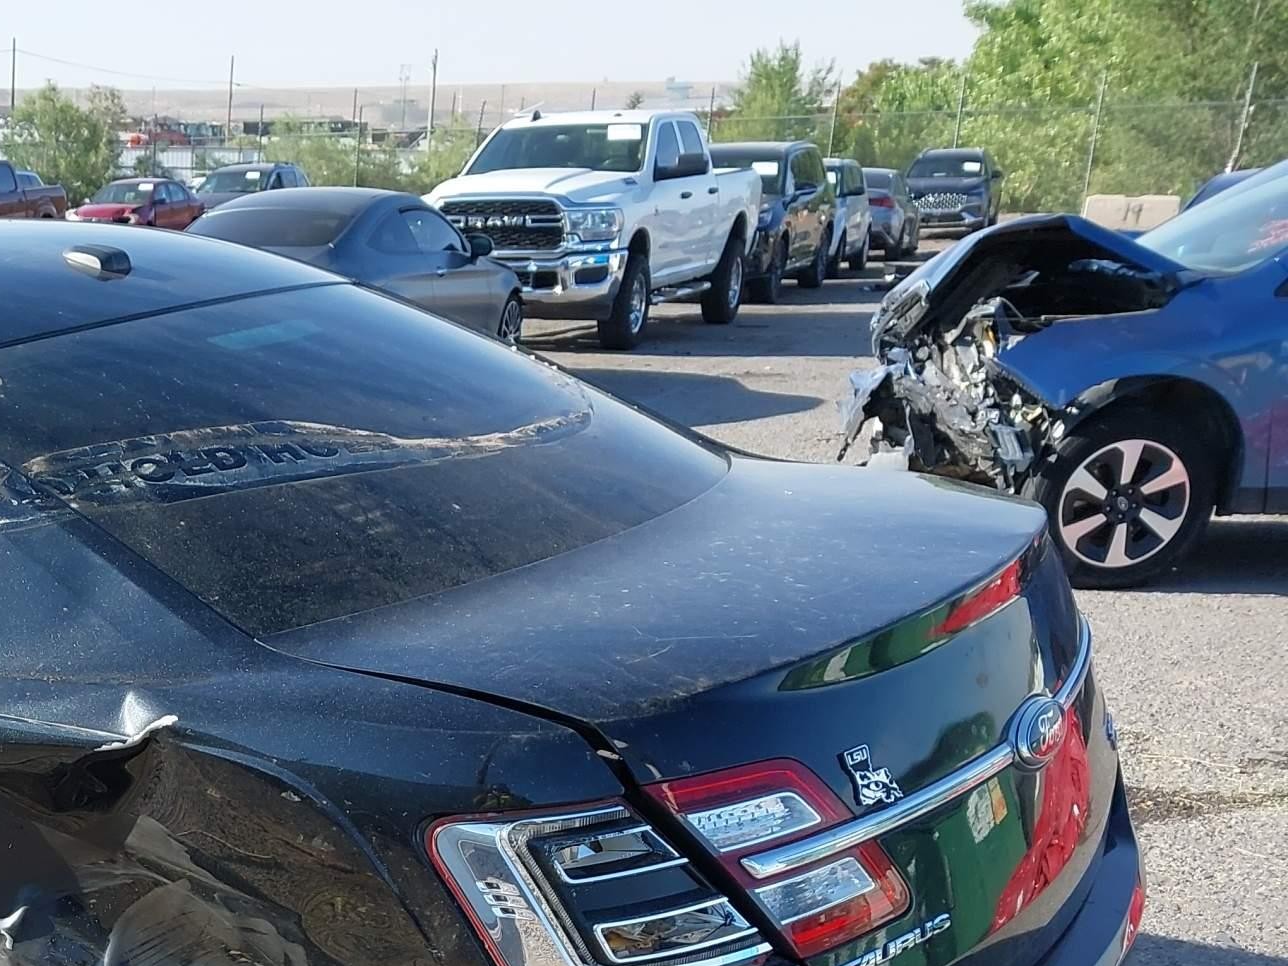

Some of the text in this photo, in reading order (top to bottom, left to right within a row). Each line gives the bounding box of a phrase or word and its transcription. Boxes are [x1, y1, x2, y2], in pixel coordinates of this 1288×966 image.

[468, 215, 525, 229] RAM
[1038, 710, 1063, 752] Ford
[847, 748, 868, 766] LSU
